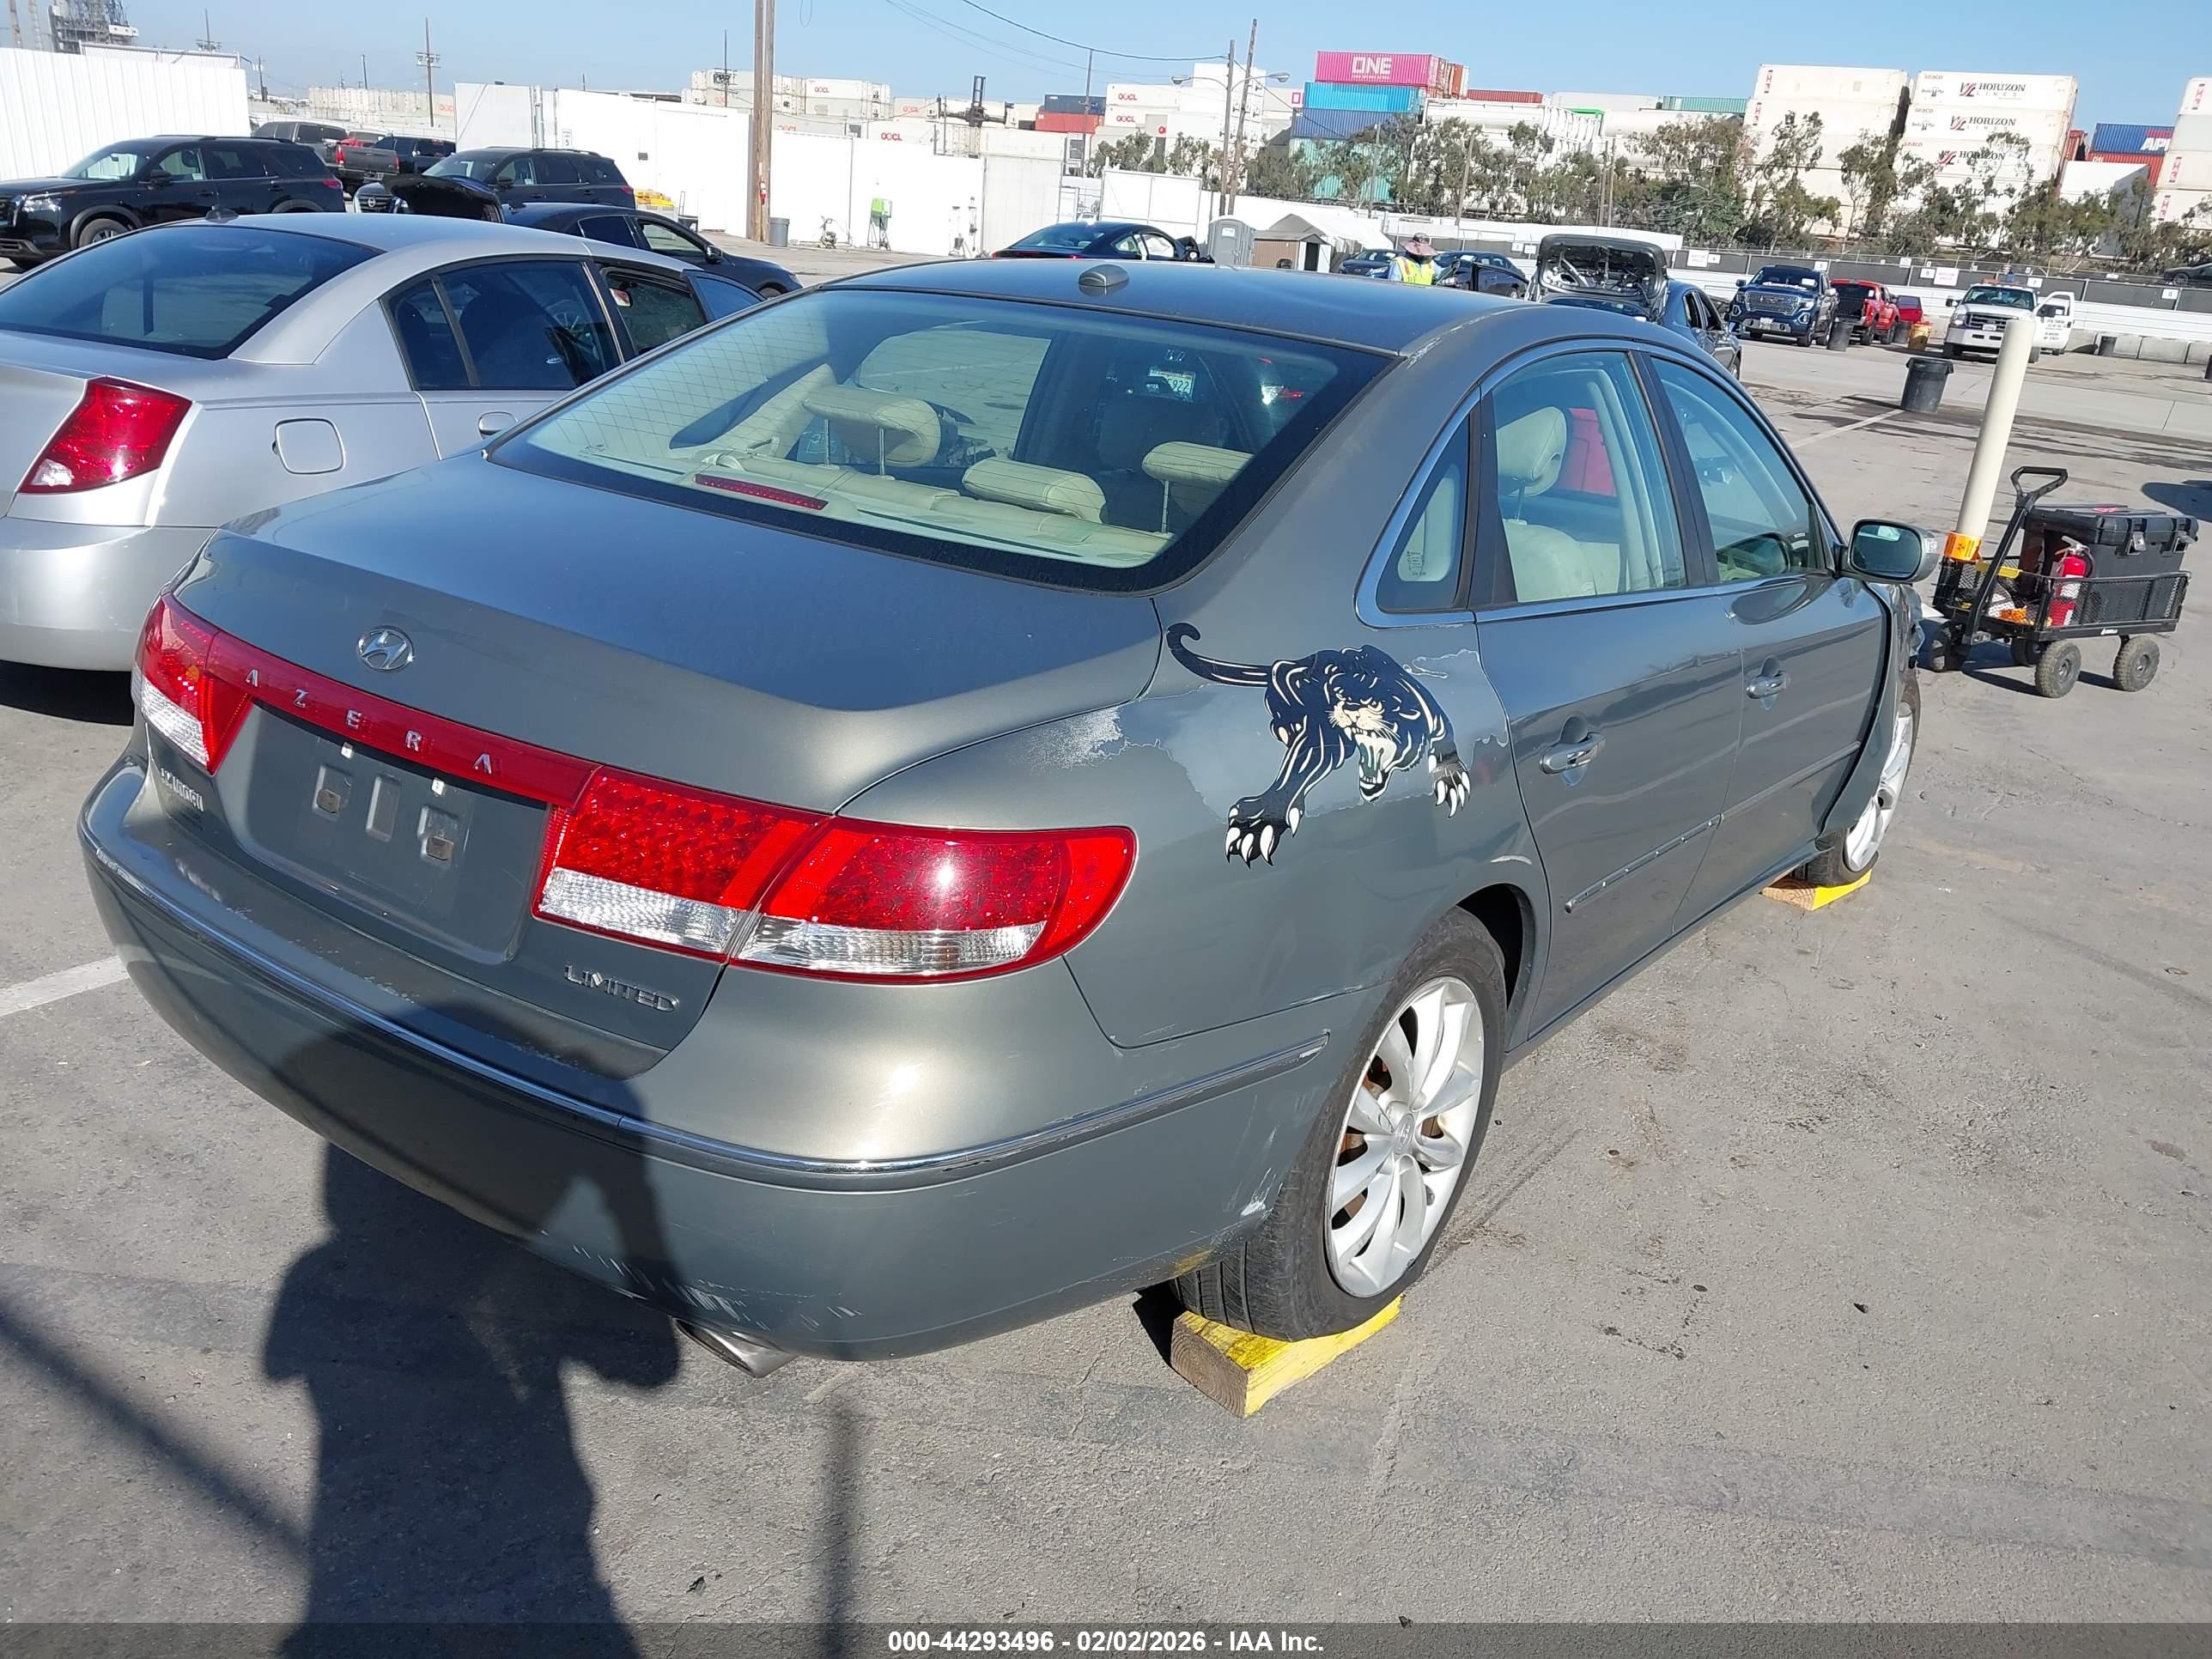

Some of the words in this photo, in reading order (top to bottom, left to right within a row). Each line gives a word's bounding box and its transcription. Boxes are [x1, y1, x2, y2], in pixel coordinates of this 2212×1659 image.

[1352, 56, 1392, 75] ONE
[1978, 82, 2027, 92] HORIZON
[1968, 116, 2017, 126] HORIZON
[880, 132, 902, 142] OOCL
[246, 667, 493, 775] AZERA
[564, 963, 680, 1013] LIMITED
